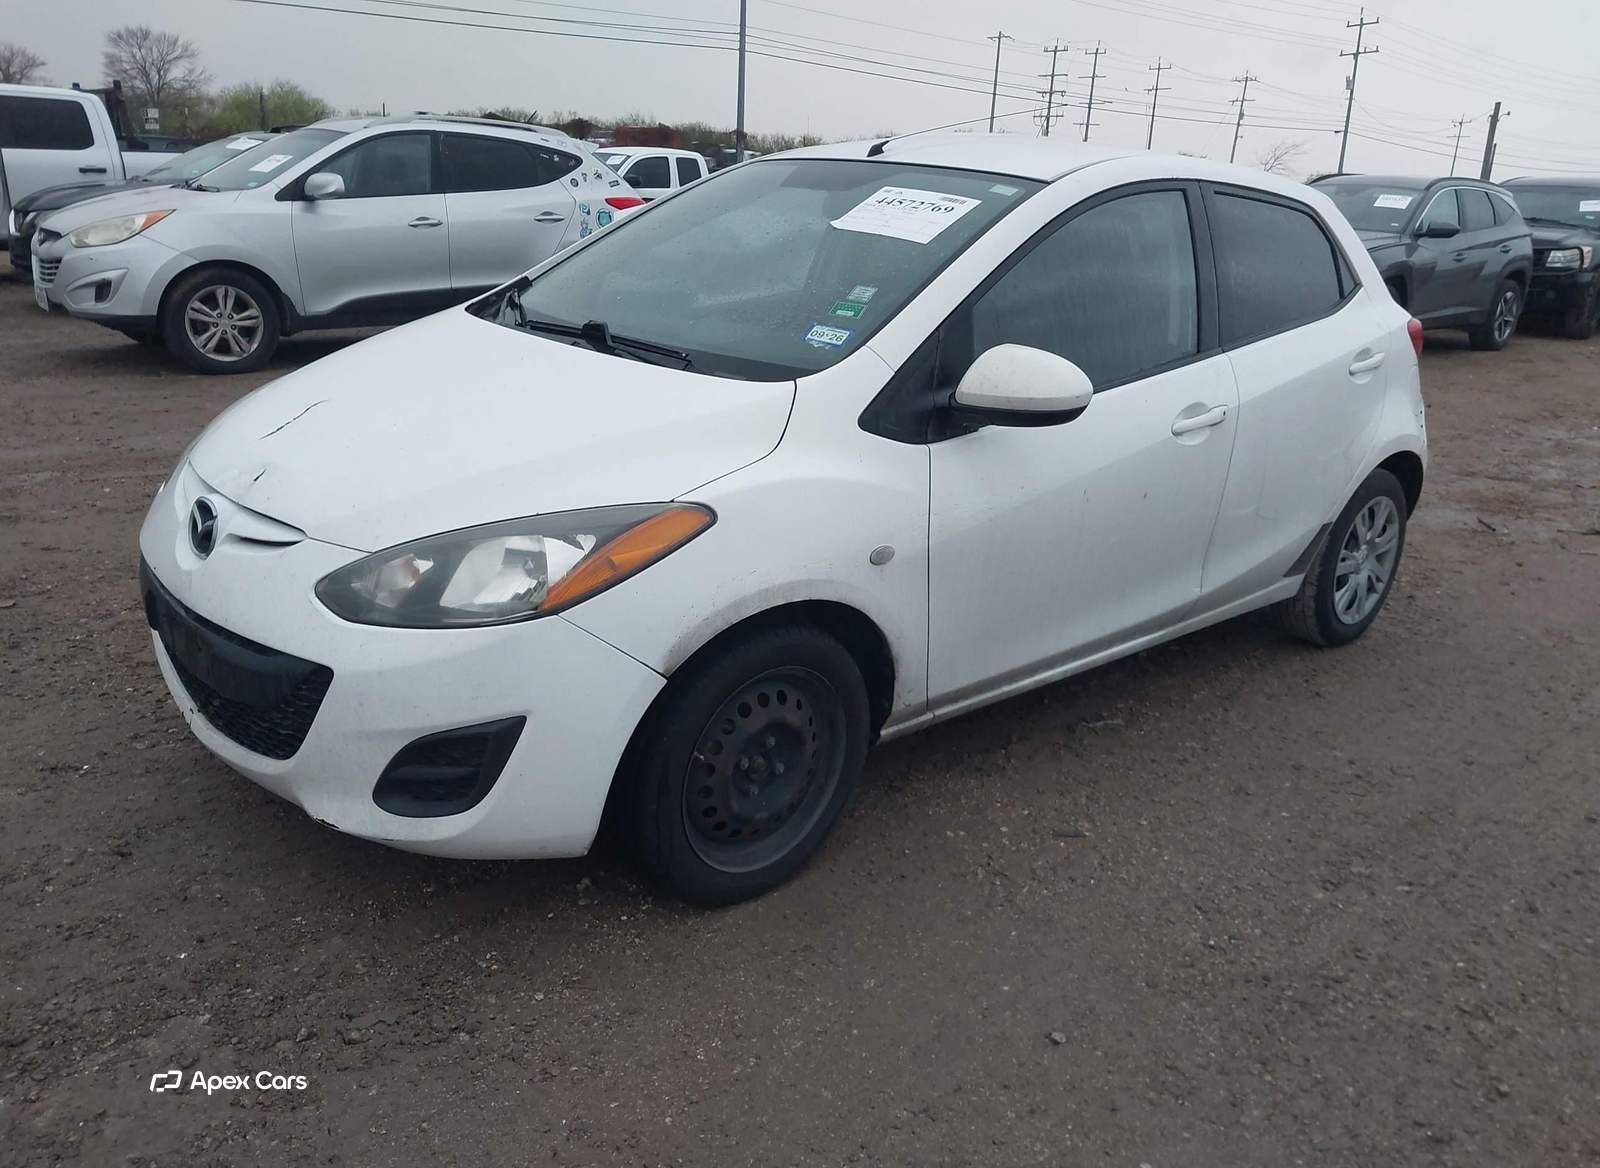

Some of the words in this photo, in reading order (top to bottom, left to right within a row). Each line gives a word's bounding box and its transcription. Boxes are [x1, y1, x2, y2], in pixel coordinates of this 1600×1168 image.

[875, 196, 955, 214] 44572769
[810, 330, 825, 338] 09
[828, 333, 845, 342] 26
